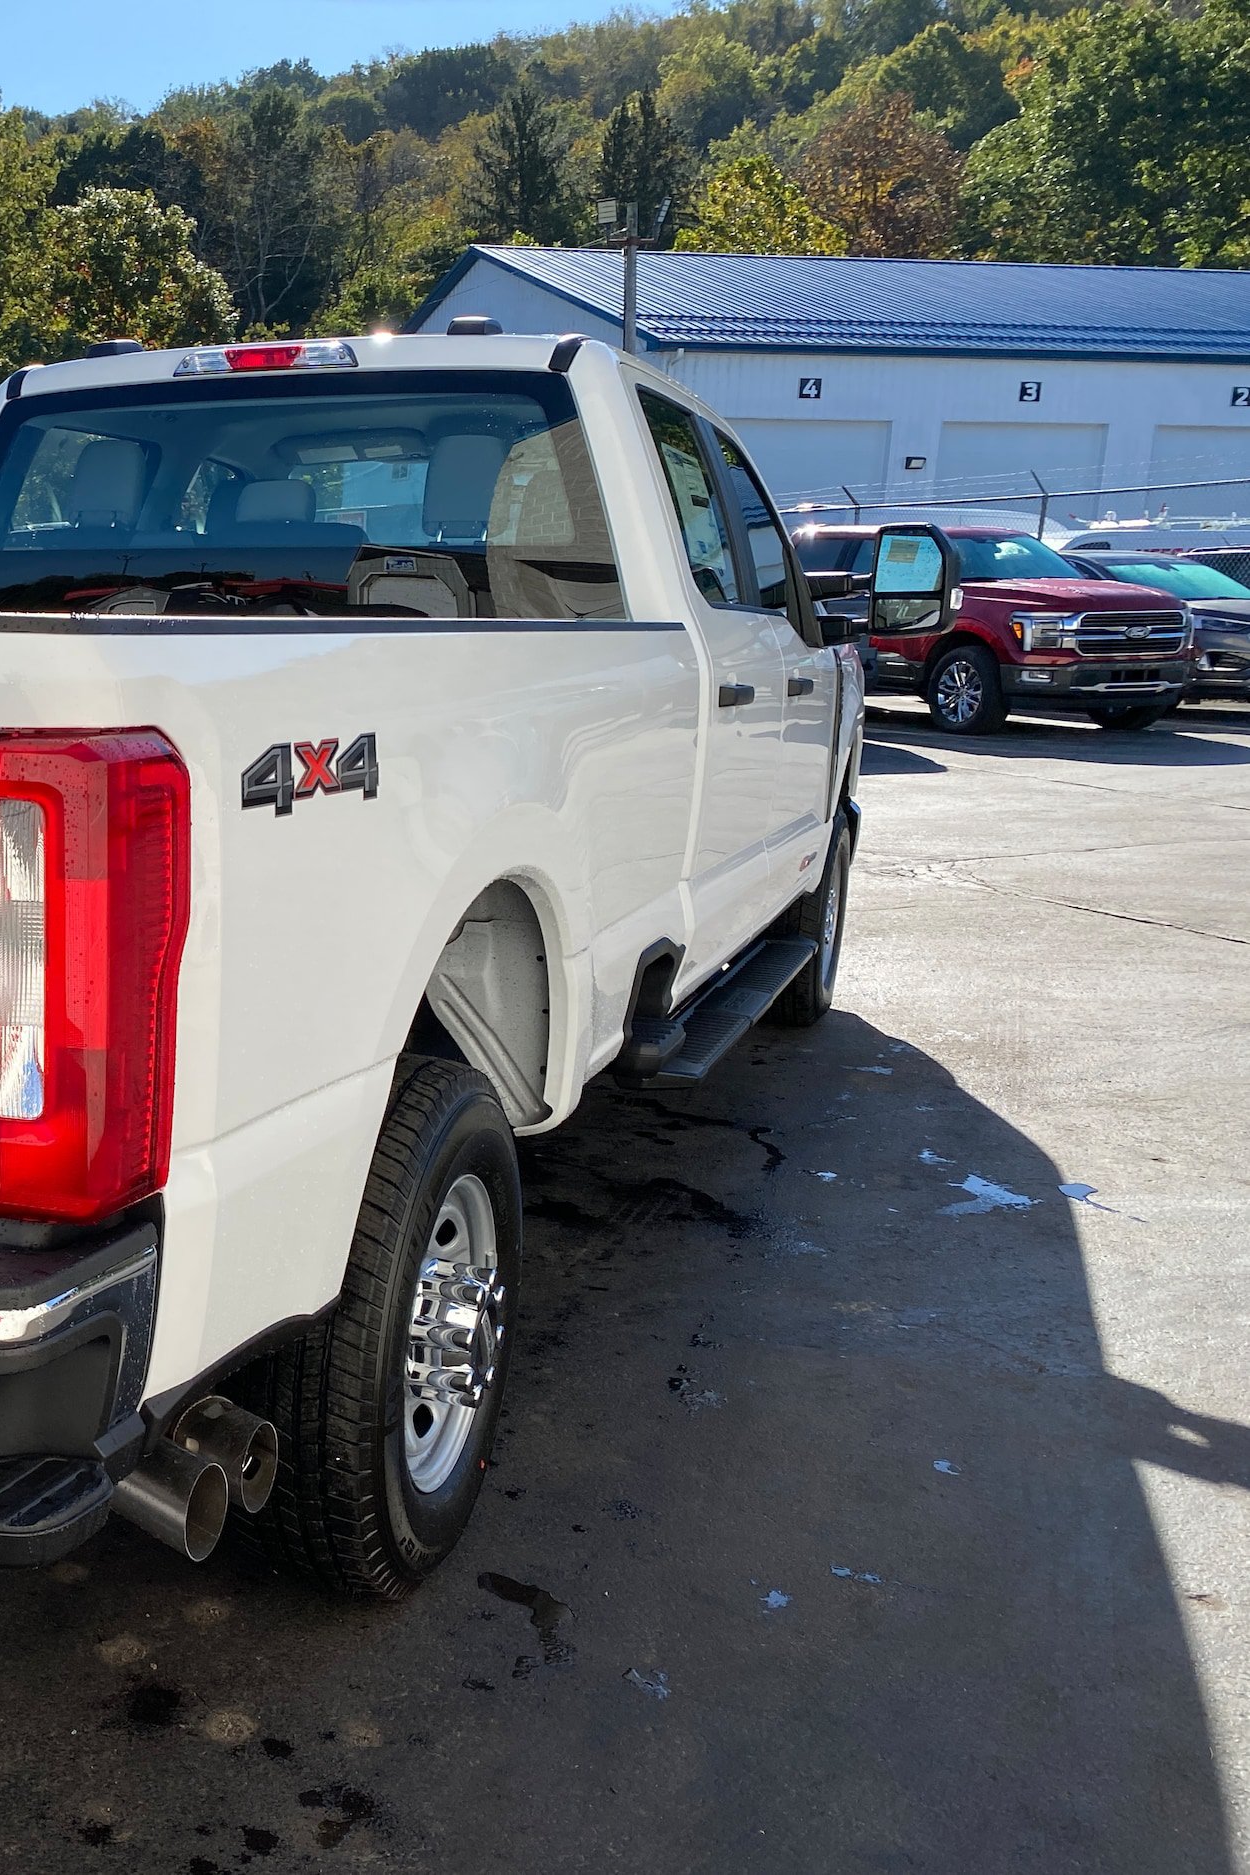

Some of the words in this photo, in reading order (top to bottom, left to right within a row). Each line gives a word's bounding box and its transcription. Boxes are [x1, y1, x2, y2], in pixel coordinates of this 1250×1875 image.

[802, 379, 818, 398] 4
[1023, 382, 1038, 401] 3
[1235, 387, 1249, 406] 2
